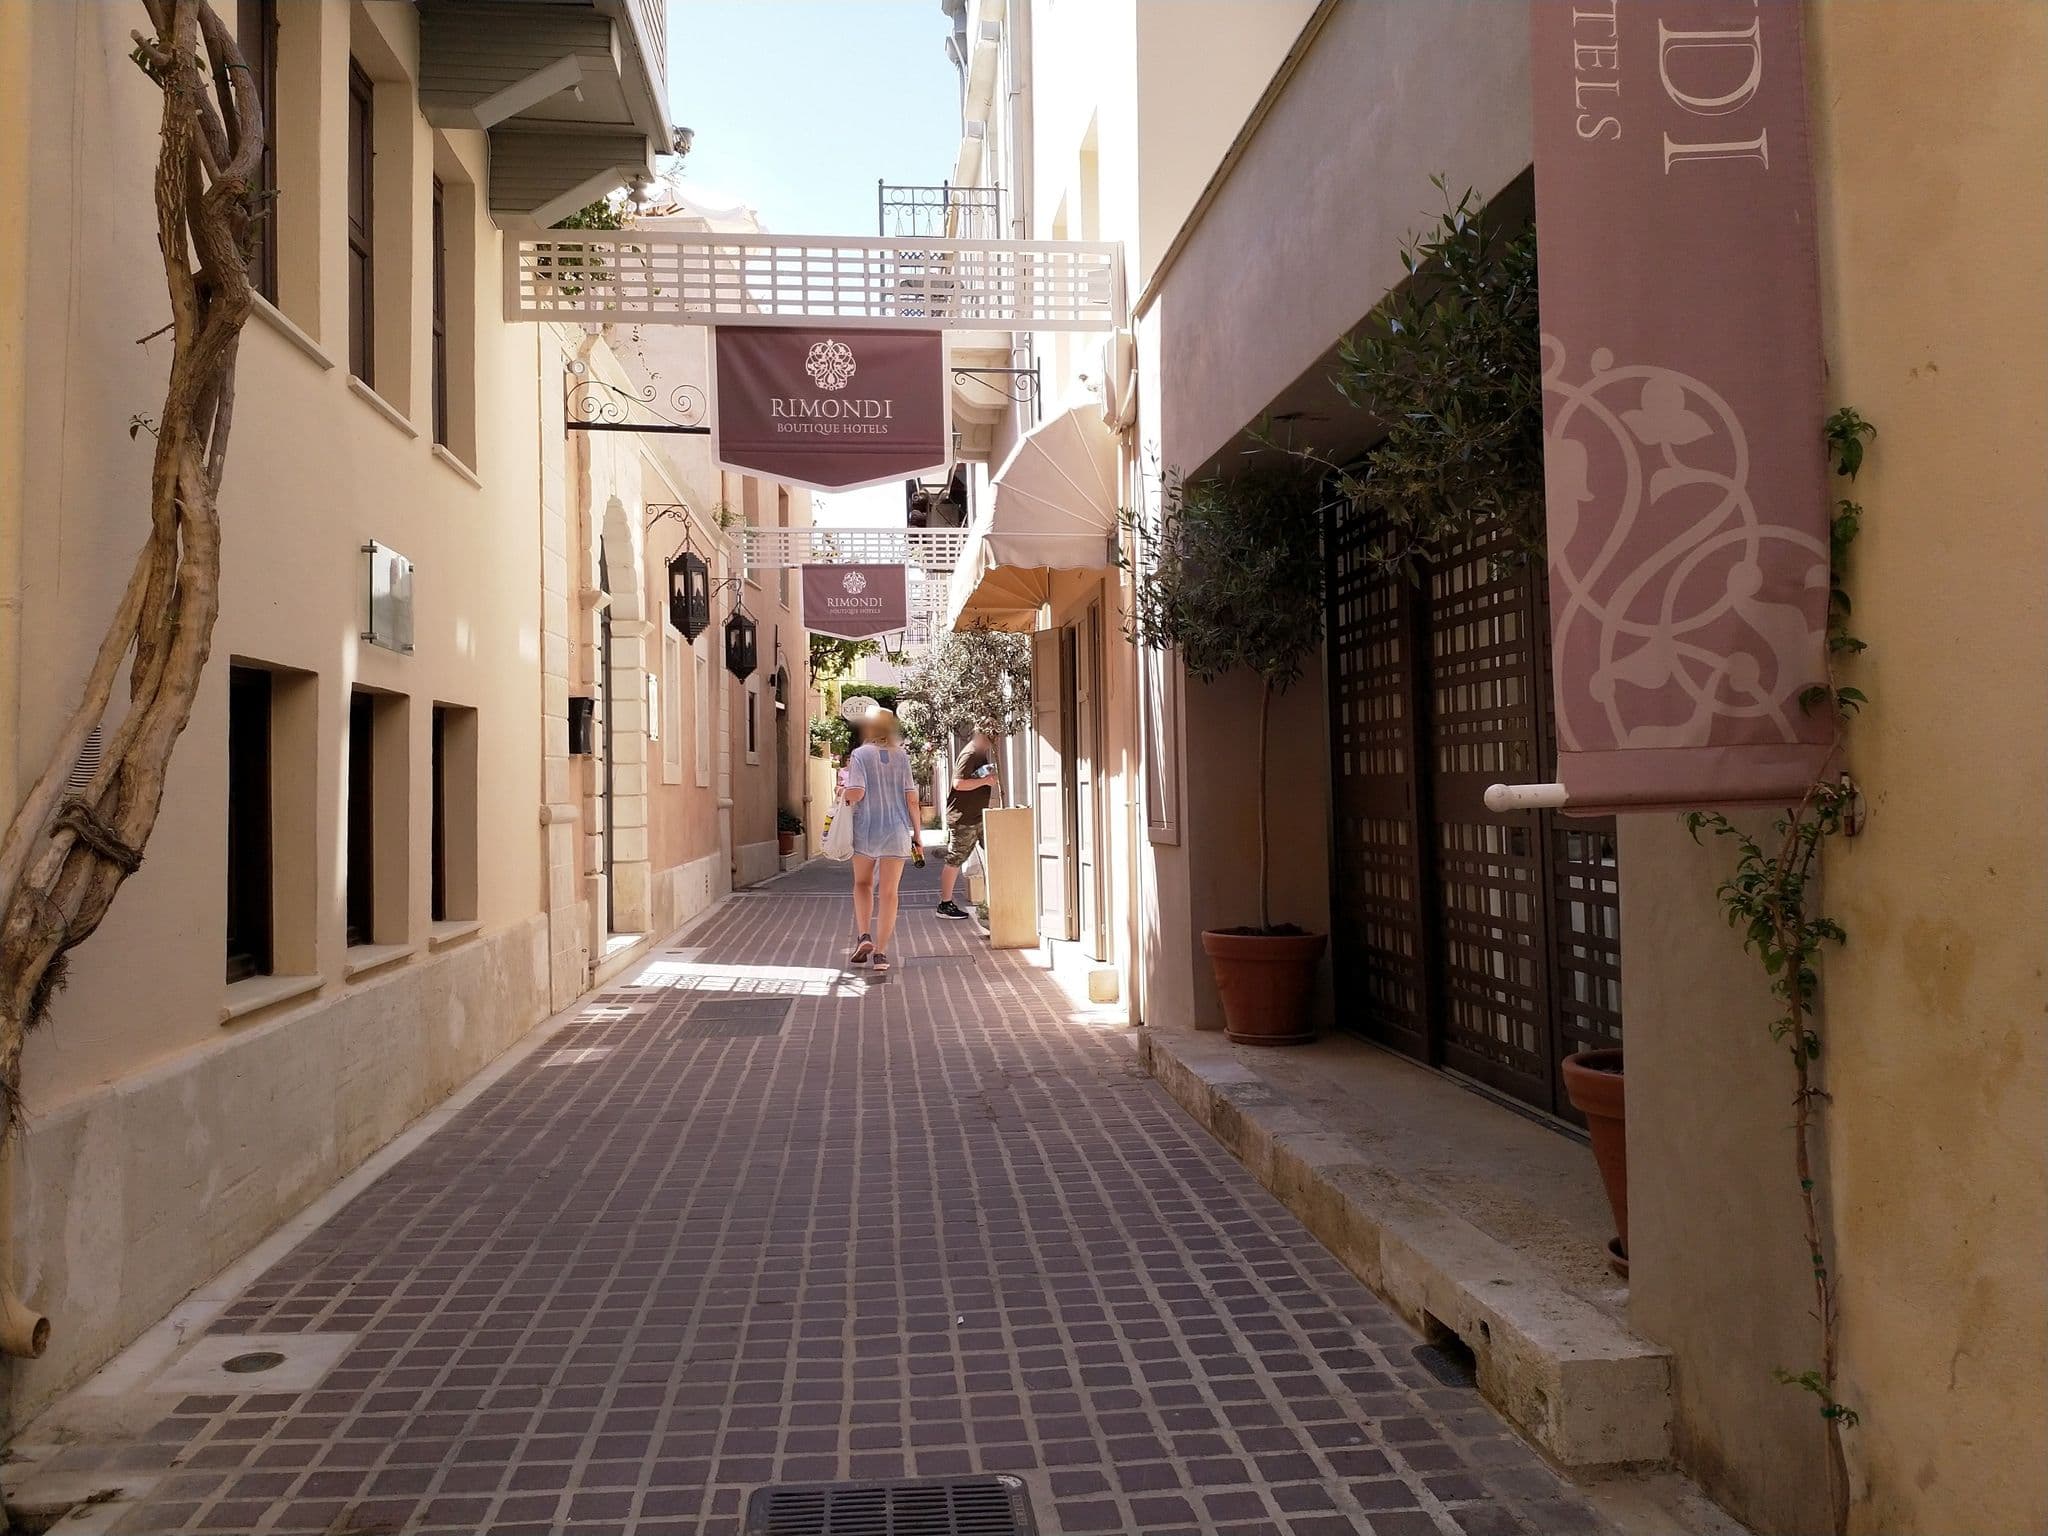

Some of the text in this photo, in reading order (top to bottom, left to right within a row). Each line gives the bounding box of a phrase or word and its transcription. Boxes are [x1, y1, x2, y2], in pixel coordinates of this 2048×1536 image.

[1658, 0, 1769, 175] DI
[770, 397, 894, 419] RIMONDI
[777, 422, 888, 436] BOUTIQUE HOTELS
[827, 597, 883, 607] RIMONDI
